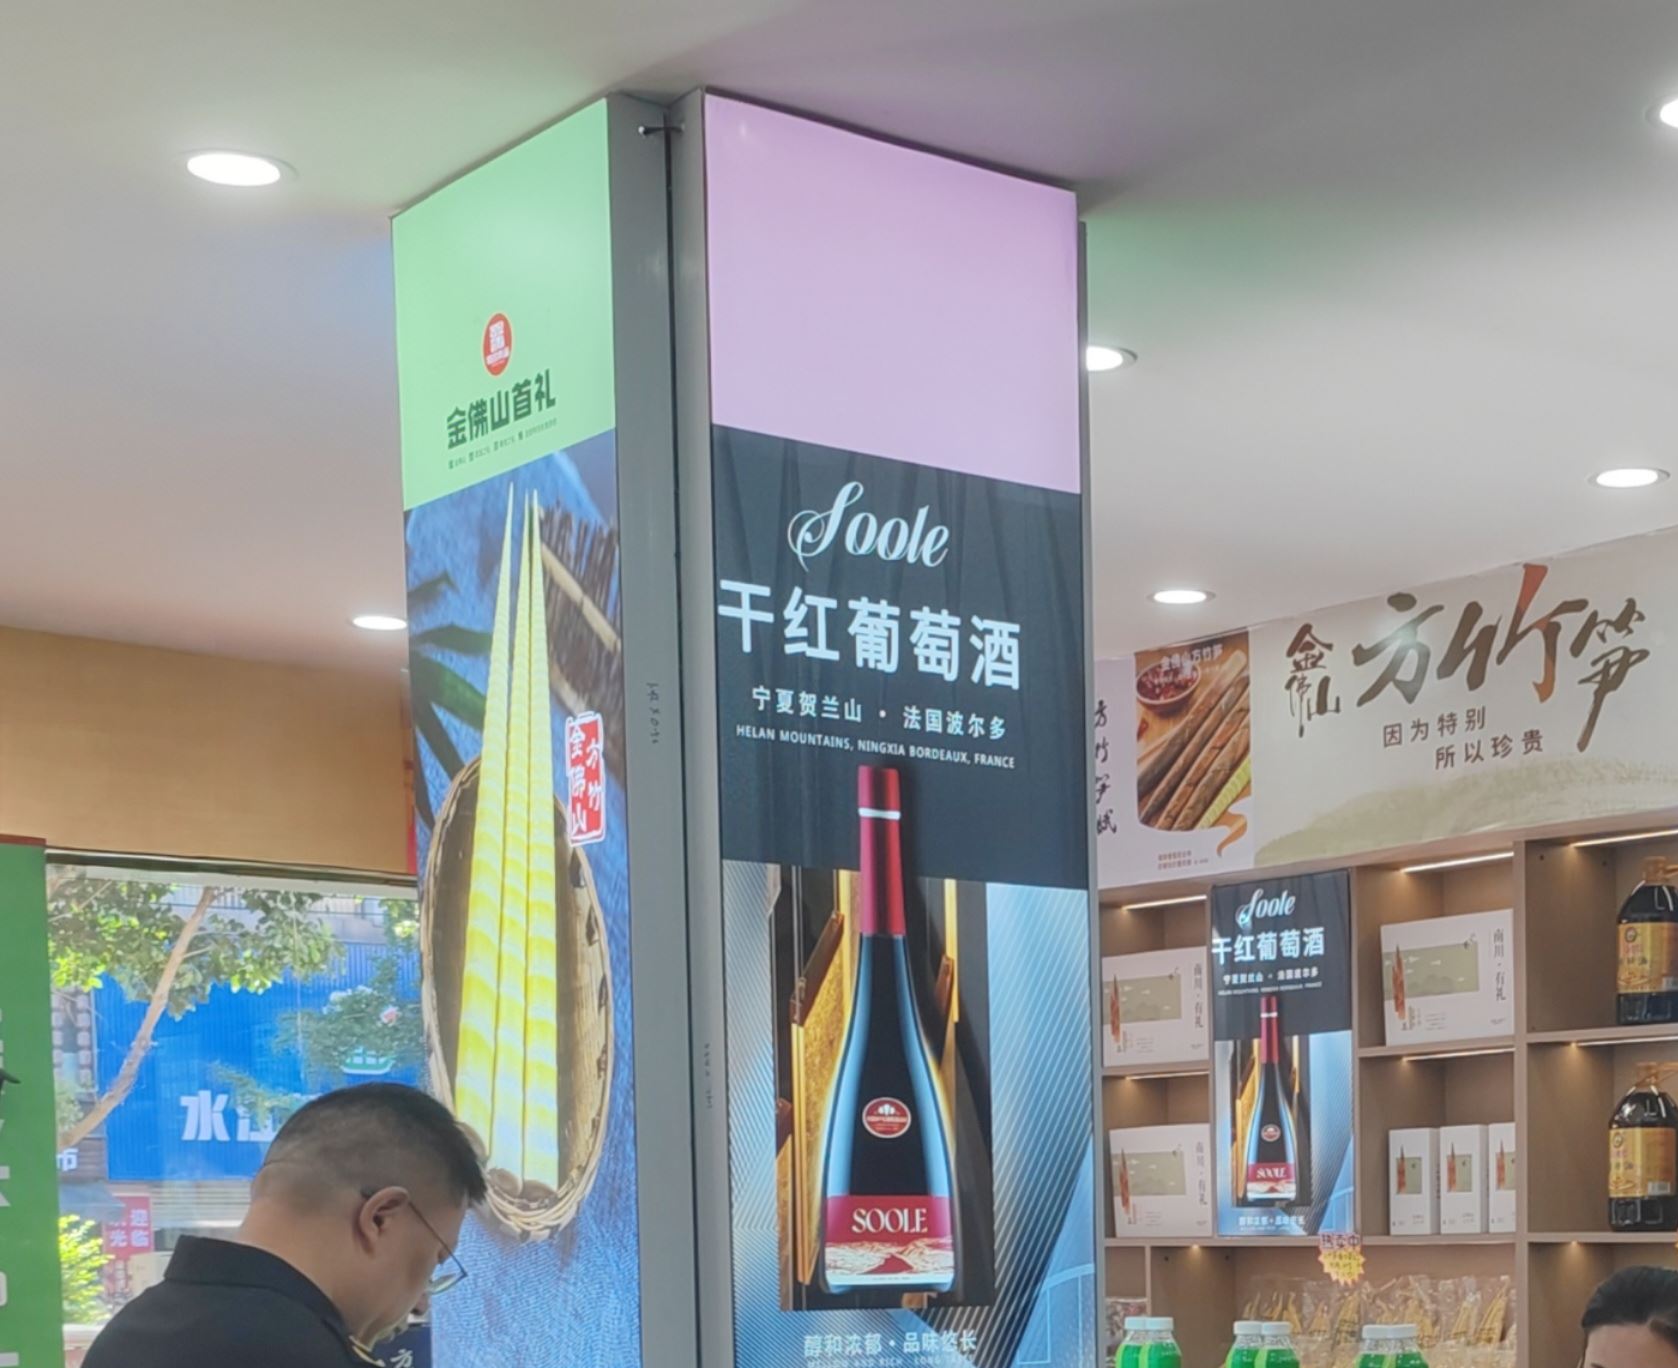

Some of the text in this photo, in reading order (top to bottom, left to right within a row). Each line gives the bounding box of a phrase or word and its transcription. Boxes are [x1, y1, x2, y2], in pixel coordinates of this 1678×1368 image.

[718, 579, 1020, 690] 干红葡萄酒
[1351, 560, 1650, 753] 方竹笋
[752, 685, 862, 723] 宁夏贺兰山
[903, 705, 1006, 740] 法国波尔多
[1383, 706, 1486, 748] 因为特别
[736, 724, 1016, 769] HELAN MOUNTAINS, NINGXIA BORDEAUX, FRANCE
[1435, 729, 1544, 770] 所以珍贵
[1211, 927, 1325, 965] 干红葡萄酒
[852, 1207, 928, 1234] SOOLE
